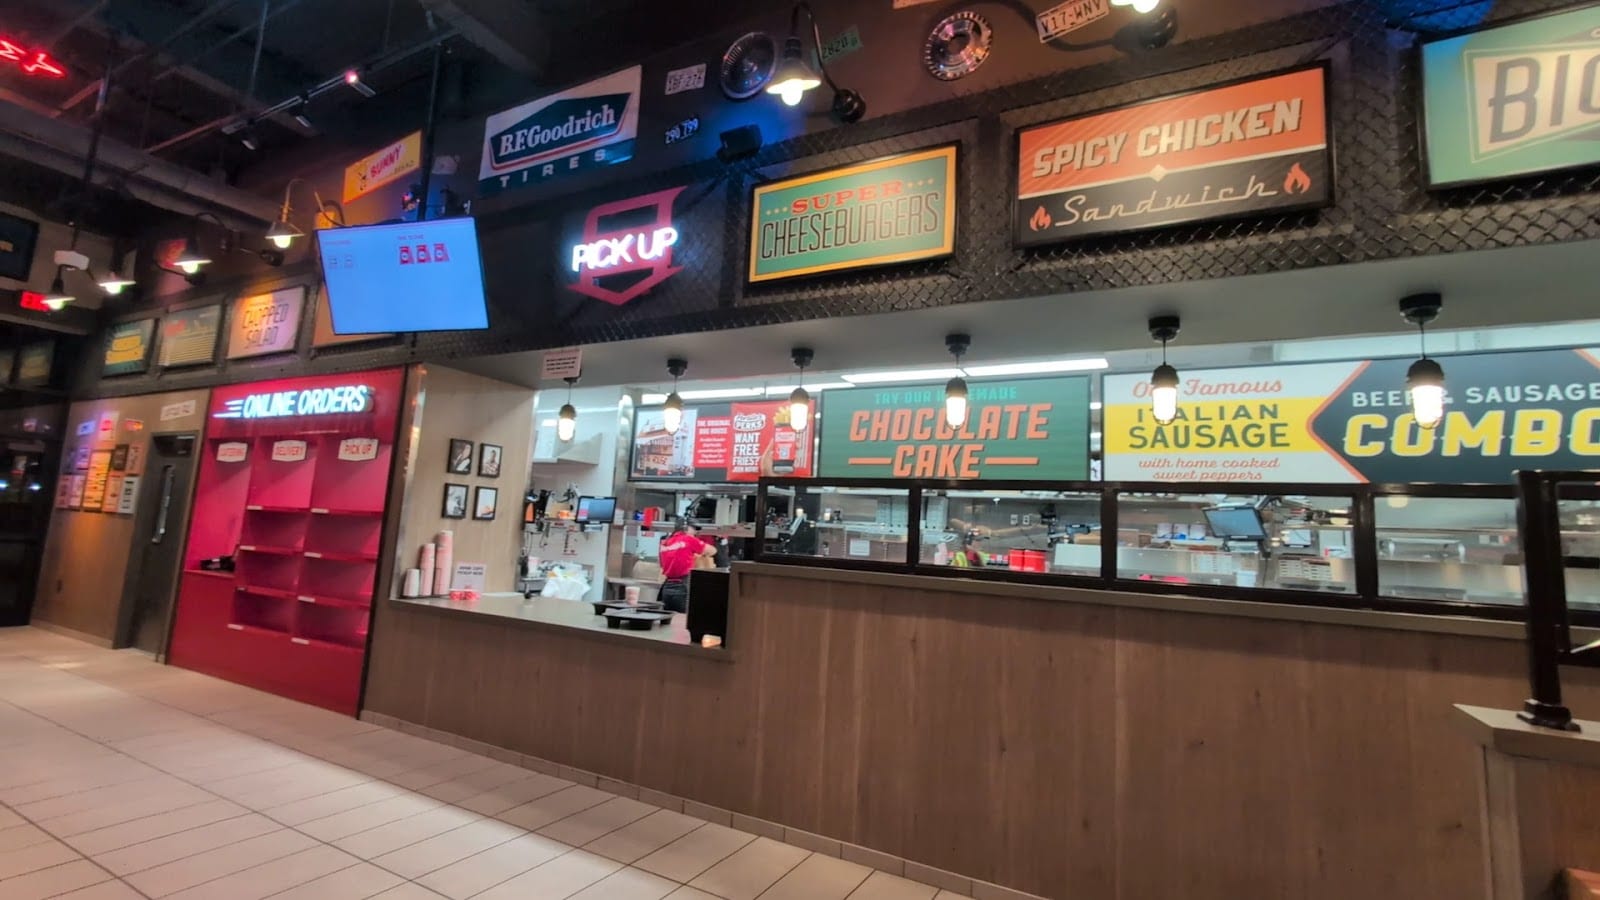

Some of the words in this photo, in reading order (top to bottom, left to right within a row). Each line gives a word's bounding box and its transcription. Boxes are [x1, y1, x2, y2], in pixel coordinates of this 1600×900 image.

[1031, 131, 1128, 178] SPICY
[1136, 98, 1302, 158] CHICKEN
[370, 143, 402, 178] BUNNY
[499, 149, 606, 188] TIRES
[791, 180, 904, 215] SUPER
[1055, 174, 1278, 228] Sandwich
[761, 192, 940, 260] CHEESEBURGERS
[571, 233, 633, 273] PICK
[636, 226, 678, 260] UP
[243, 303, 289, 329] CHOPPED
[243, 390, 298, 419] ONLINE
[297, 384, 369, 416] ORDERS
[874, 391, 898, 405] TRY
[904, 390, 931, 404] OUR
[1183, 379, 1283, 397] Famous
[734, 420, 764, 430] PERKS
[735, 432, 759, 443] WANT
[1128, 422, 1291, 450] SAUSAGE
[344, 444, 360, 456] PICK
[361, 442, 373, 455] UP
[732, 456, 761, 466] FRIES?
[734, 444, 760, 456] FREE
[892, 443, 985, 479] CAKE
[1138, 458, 1173, 470] with
[1175, 458, 1218, 470] home
[1222, 457, 1281, 469] cooked
[1153, 469, 1196, 481] sweet
[1200, 470, 1263, 482] peppers
